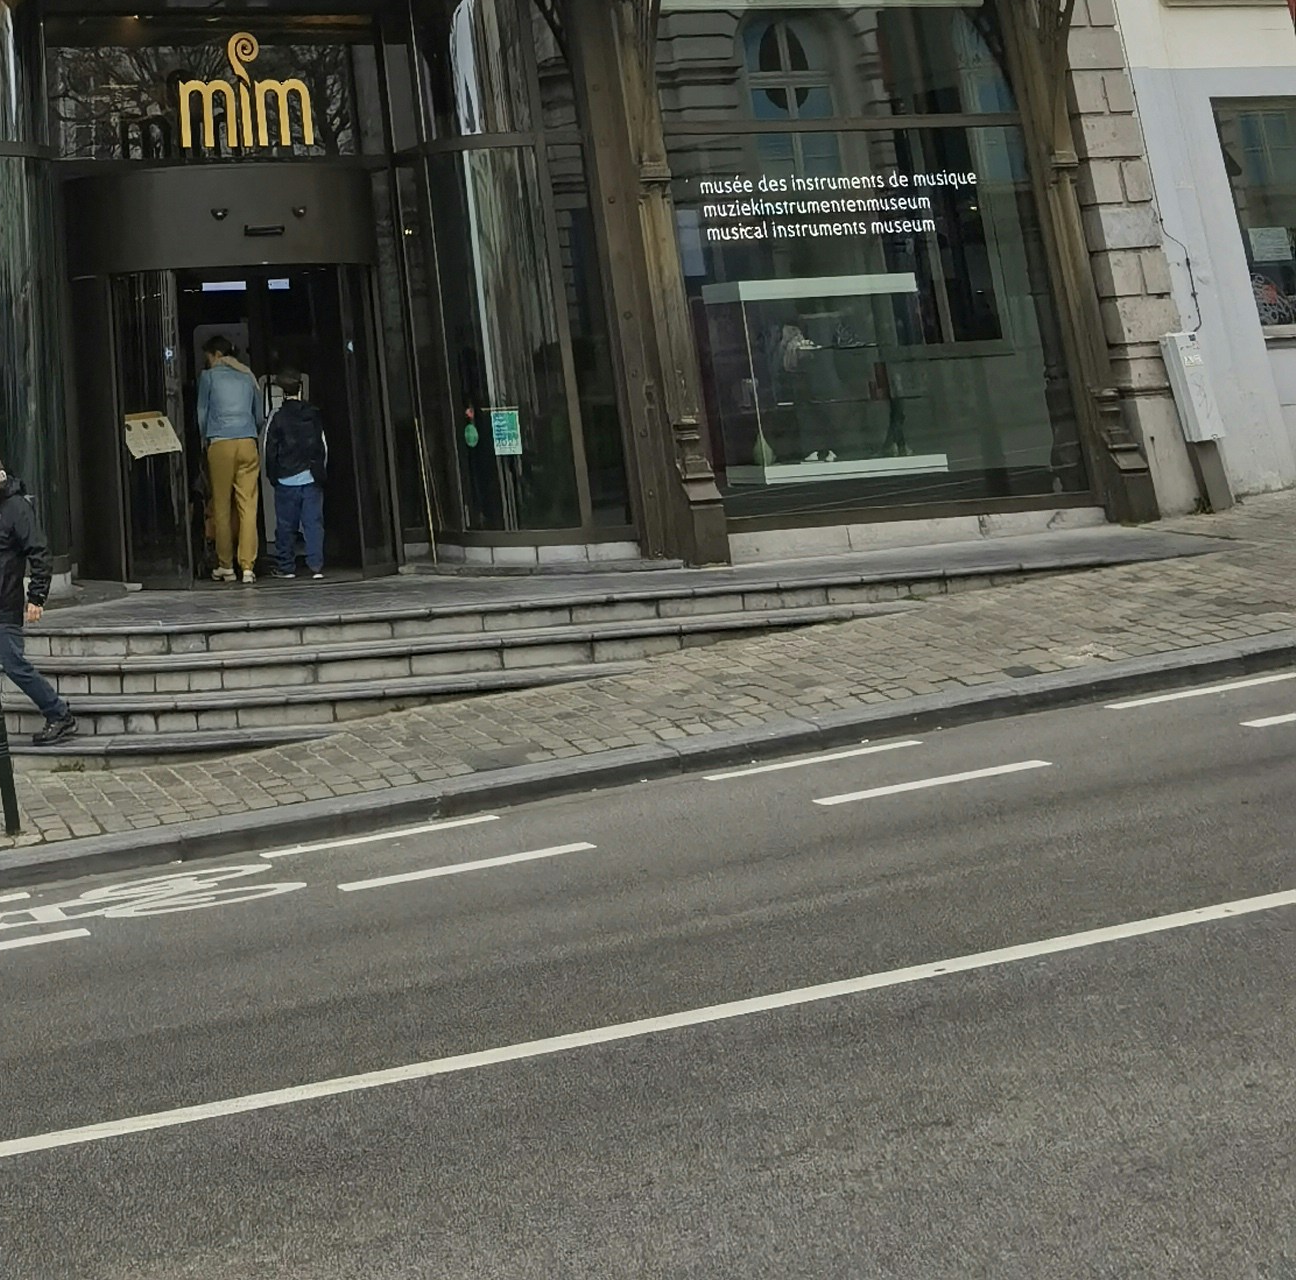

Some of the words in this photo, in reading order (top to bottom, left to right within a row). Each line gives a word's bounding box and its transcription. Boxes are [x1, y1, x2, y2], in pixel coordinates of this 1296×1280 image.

[178, 31, 314, 149] mim
[699, 175, 753, 195] musée
[757, 173, 787, 193] des
[791, 173, 885, 192] instruments
[888, 170, 909, 188] de
[913, 168, 977, 191] musique
[703, 195, 931, 218] muziekinstrumentenmuseum
[706, 220, 768, 242] musical
[772, 220, 867, 239] instruments
[870, 217, 936, 235] museum
